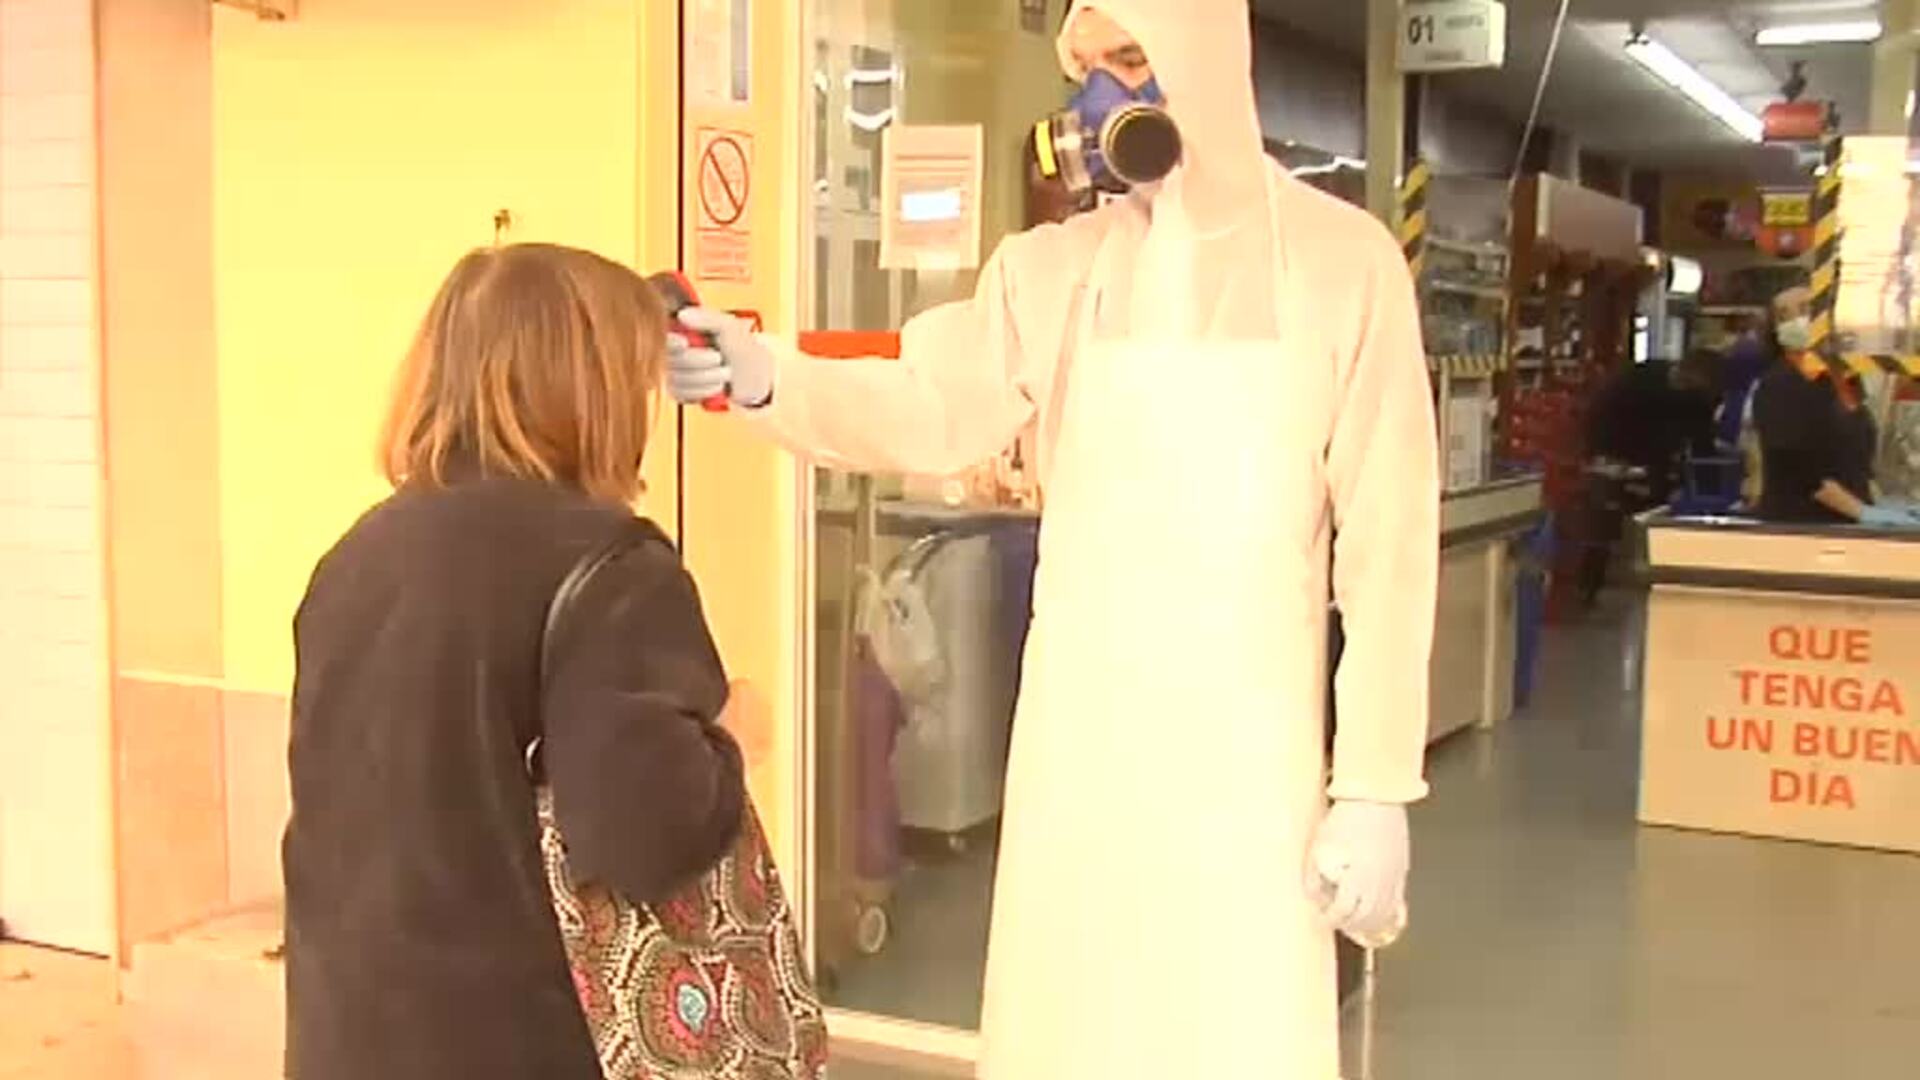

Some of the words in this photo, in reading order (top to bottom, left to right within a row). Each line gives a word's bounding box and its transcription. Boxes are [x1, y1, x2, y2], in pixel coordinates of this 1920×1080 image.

[1408, 14, 1434, 45] 01
[1768, 625, 1871, 664] QUE
[1734, 669, 1904, 716] TENGA
[1706, 716, 1774, 754] UN
[1793, 722, 1920, 765] BUEN
